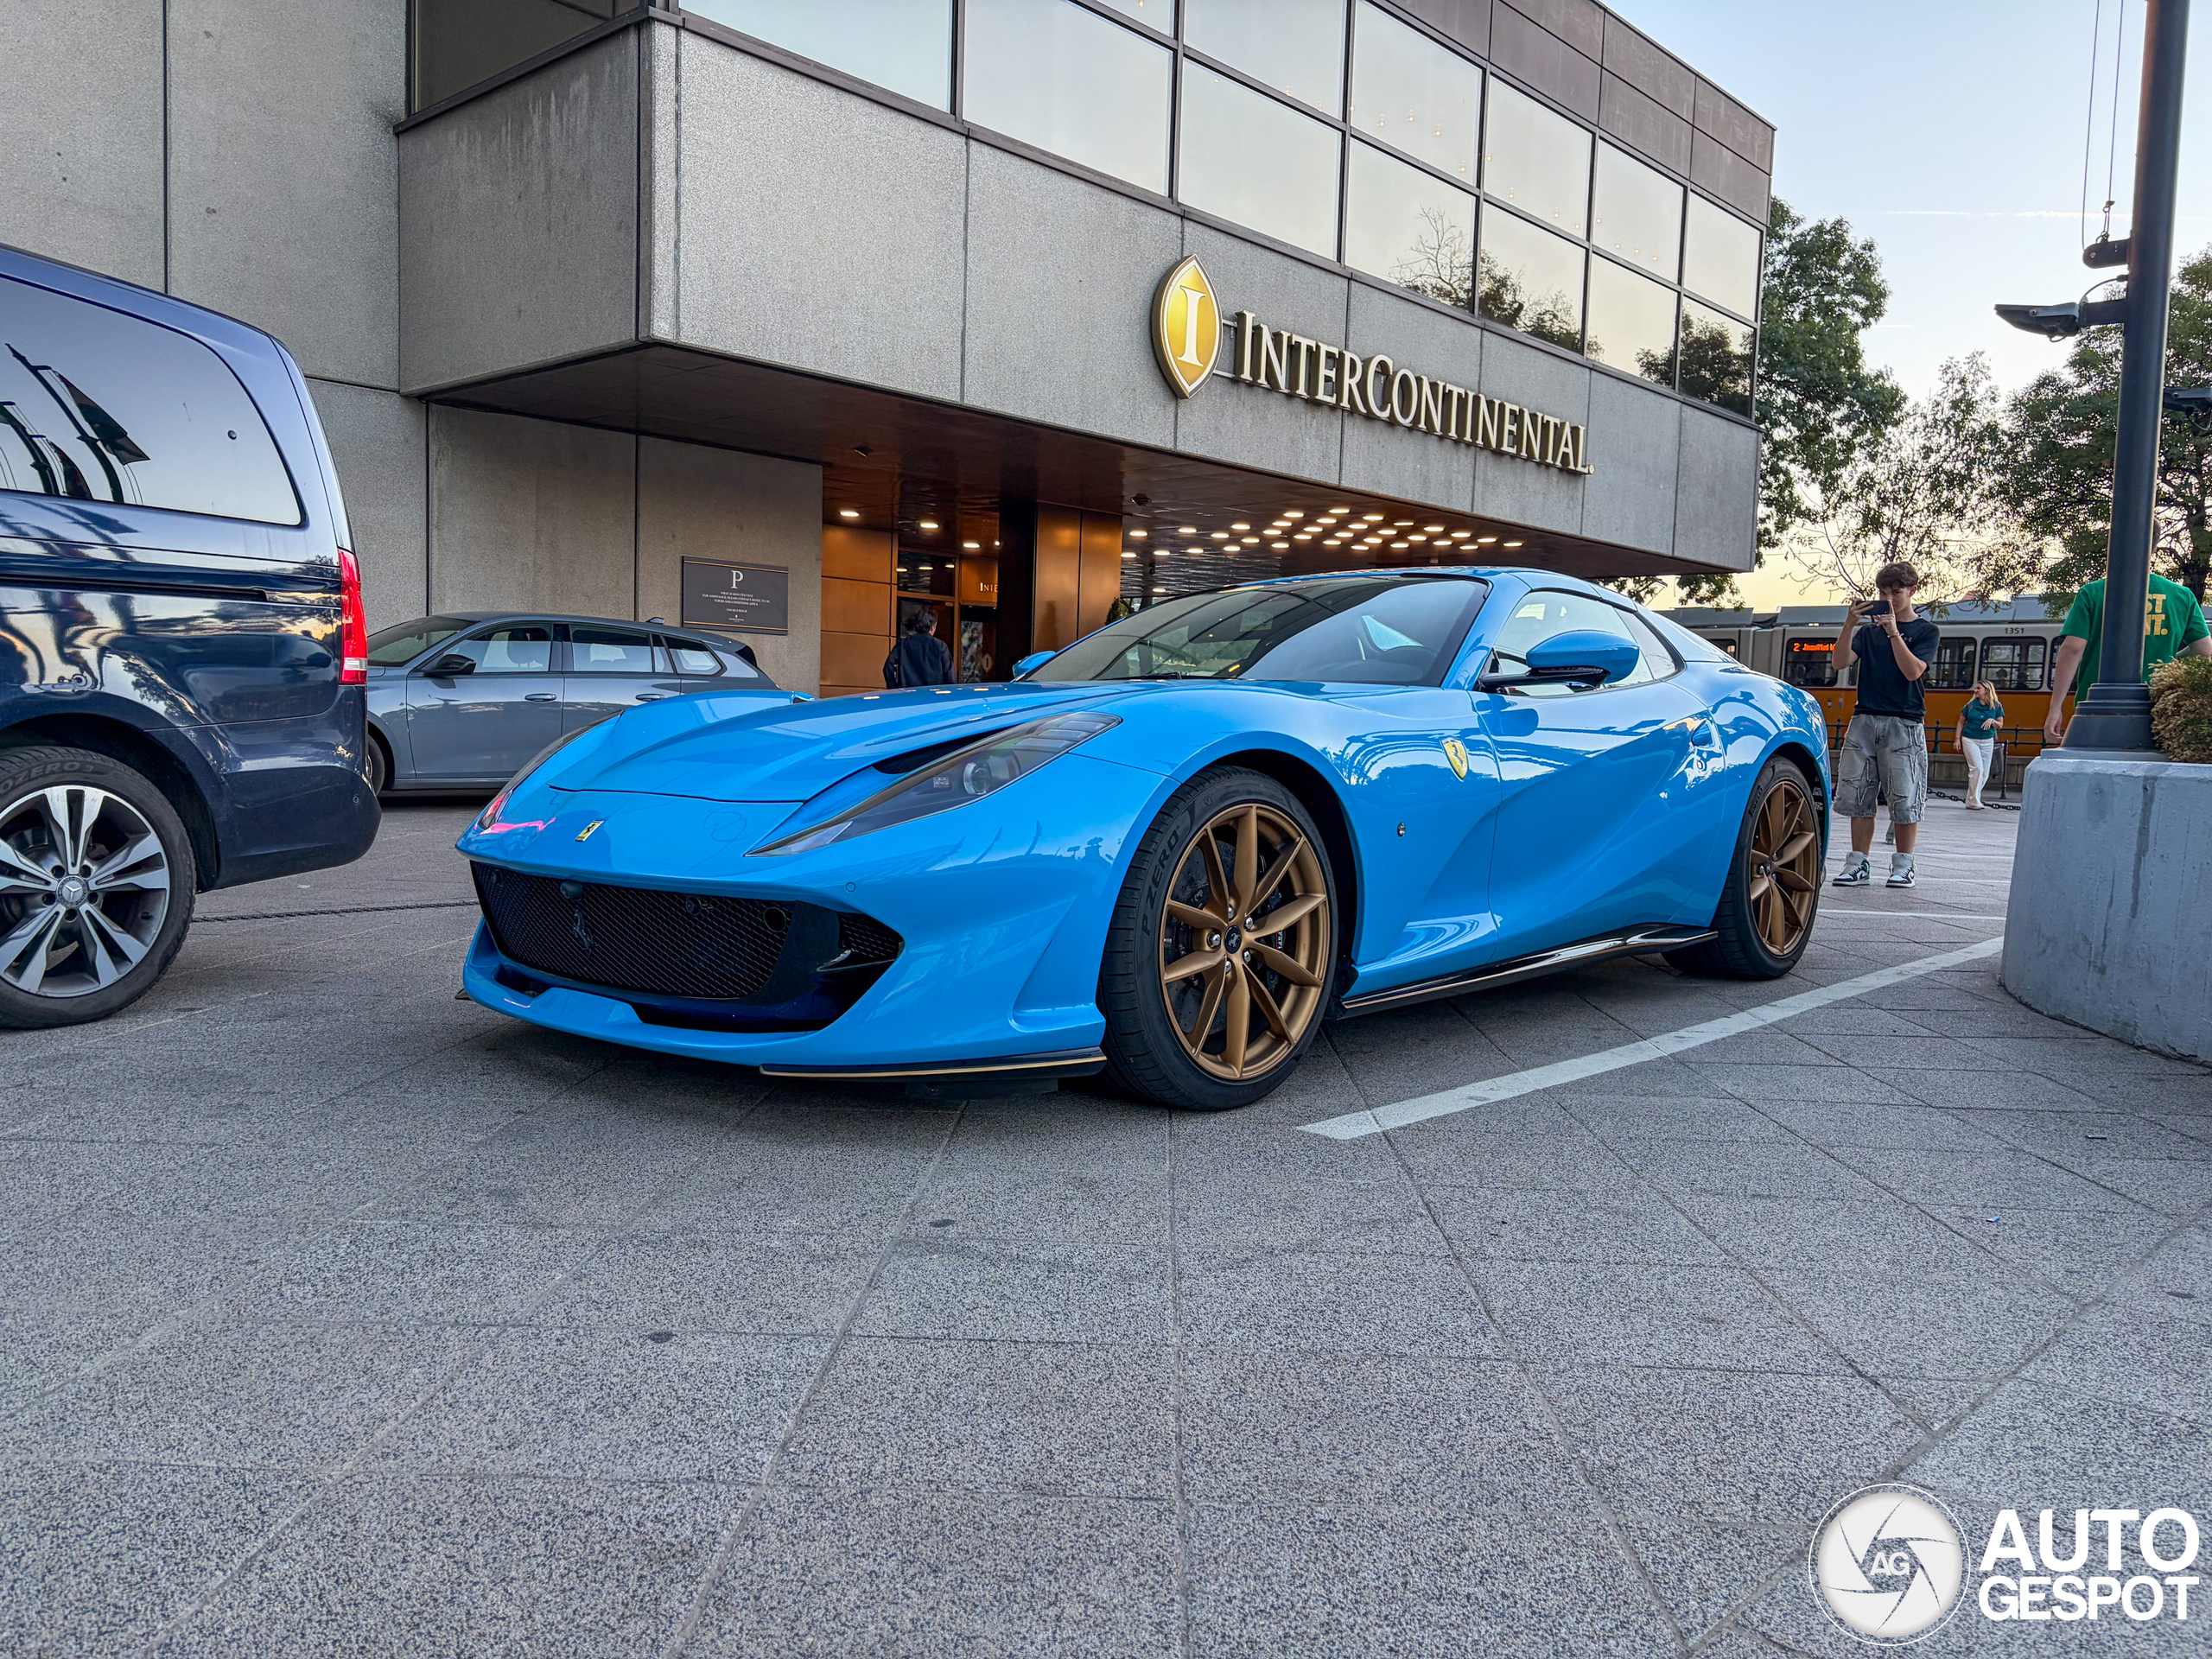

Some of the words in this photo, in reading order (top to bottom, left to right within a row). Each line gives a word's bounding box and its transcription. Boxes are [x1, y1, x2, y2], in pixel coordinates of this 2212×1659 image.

[731, 570, 743, 588] P
[1793, 643, 1801, 652] 2
[1146, 829, 1179, 910] ZERO
